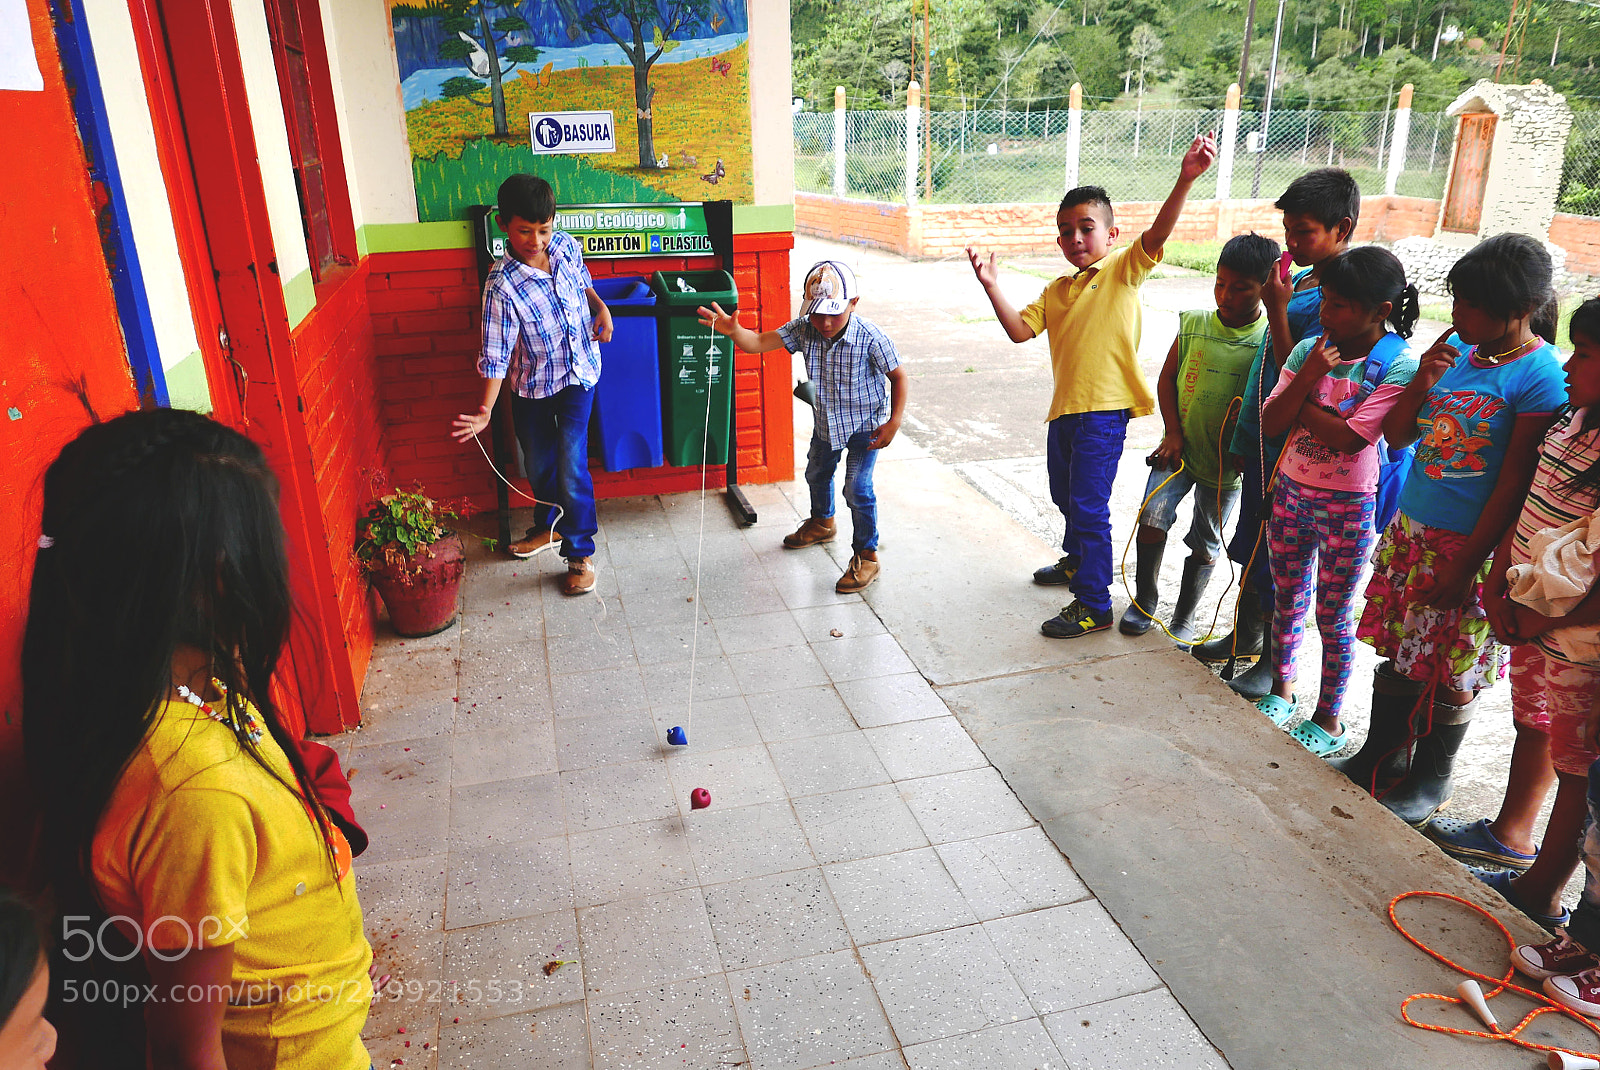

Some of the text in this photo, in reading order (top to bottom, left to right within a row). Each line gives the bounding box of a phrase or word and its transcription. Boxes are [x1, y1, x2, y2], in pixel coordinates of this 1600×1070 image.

[563, 123, 611, 141] BASURA
[553, 211, 666, 230] Punto Ecológico
[587, 233, 714, 252] CARTÓN PLÁSTIC
